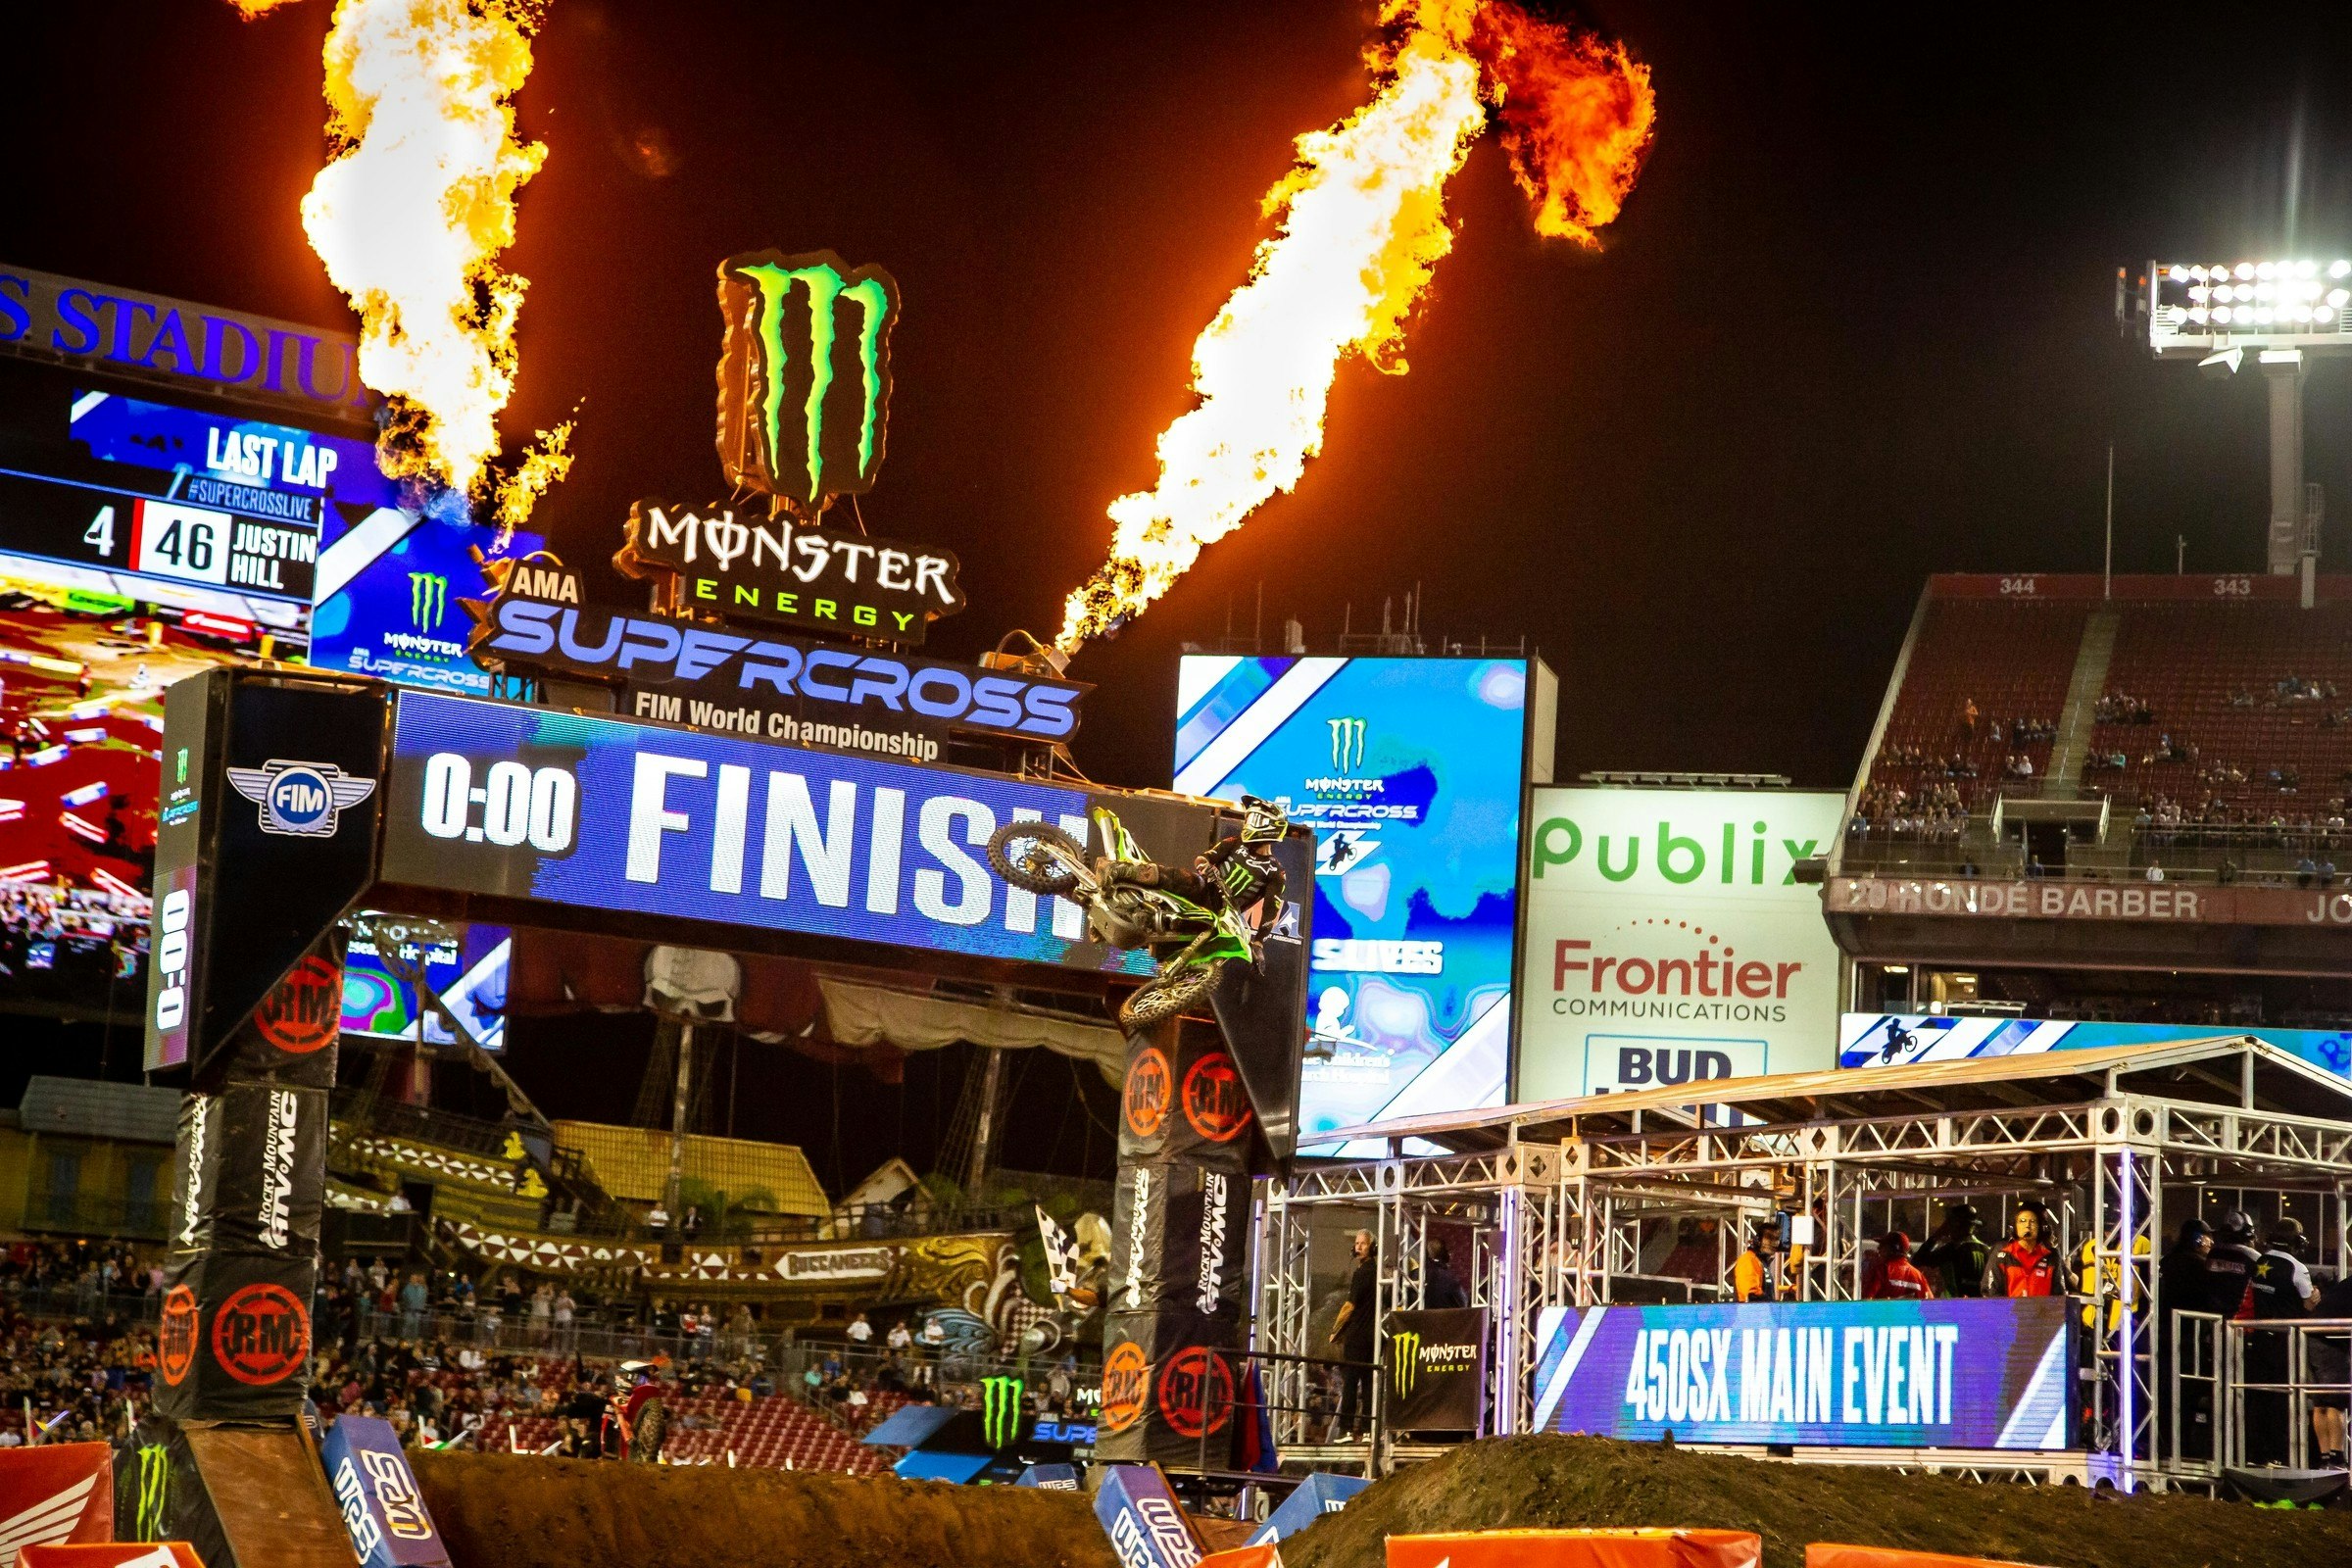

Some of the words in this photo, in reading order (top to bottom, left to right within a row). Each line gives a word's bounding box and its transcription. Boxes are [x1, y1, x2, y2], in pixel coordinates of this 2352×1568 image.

[51, 287, 372, 408] STADIU
[206, 426, 279, 479] LAST
[281, 441, 338, 489] LAP
[187, 477, 313, 521] #SUPERCROSSLIVE
[83, 505, 116, 558] 4
[155, 518, 215, 571] 46
[231, 522, 318, 564] JUSTIN
[647, 506, 957, 605] MONSTER
[230, 553, 284, 590] HILL
[512, 565, 580, 604] AMA
[2000, 578, 2035, 595] 344
[2214, 579, 2251, 595] 343
[695, 578, 914, 632] ENERGY
[489, 599, 1082, 737] SUPERCROSS
[635, 692, 682, 722] FIM
[689, 699, 761, 734] World
[766, 712, 939, 761] Championship
[276, 784, 324, 813] FIM
[1305, 776, 1385, 794] MONSTER
[421, 751, 576, 853] 0:00
[625, 751, 1090, 940] FINISH
[1533, 816, 1819, 886] Publix
[2041, 887, 2199, 920] BARBER
[1552, 939, 1802, 1000] Frontier
[1552, 998, 1787, 1023] COMMUNICATIONS
[1618, 1047, 1733, 1086] BUD
[263, 1090, 281, 1173] MOUNTAIN
[259, 1173, 276, 1225] ROCKY
[1200, 1171, 1216, 1246] MOUNTAIN
[1197, 1247, 1211, 1293] ROCKY
[229, 1312, 296, 1355] RM
[1419, 1343, 1477, 1363] MONSTER
[1427, 1364, 1471, 1373] ENERGY
[1626, 1328, 1733, 1423] 450SX
[1740, 1326, 1834, 1424] MAIN
[1842, 1324, 1959, 1425] EVENT
